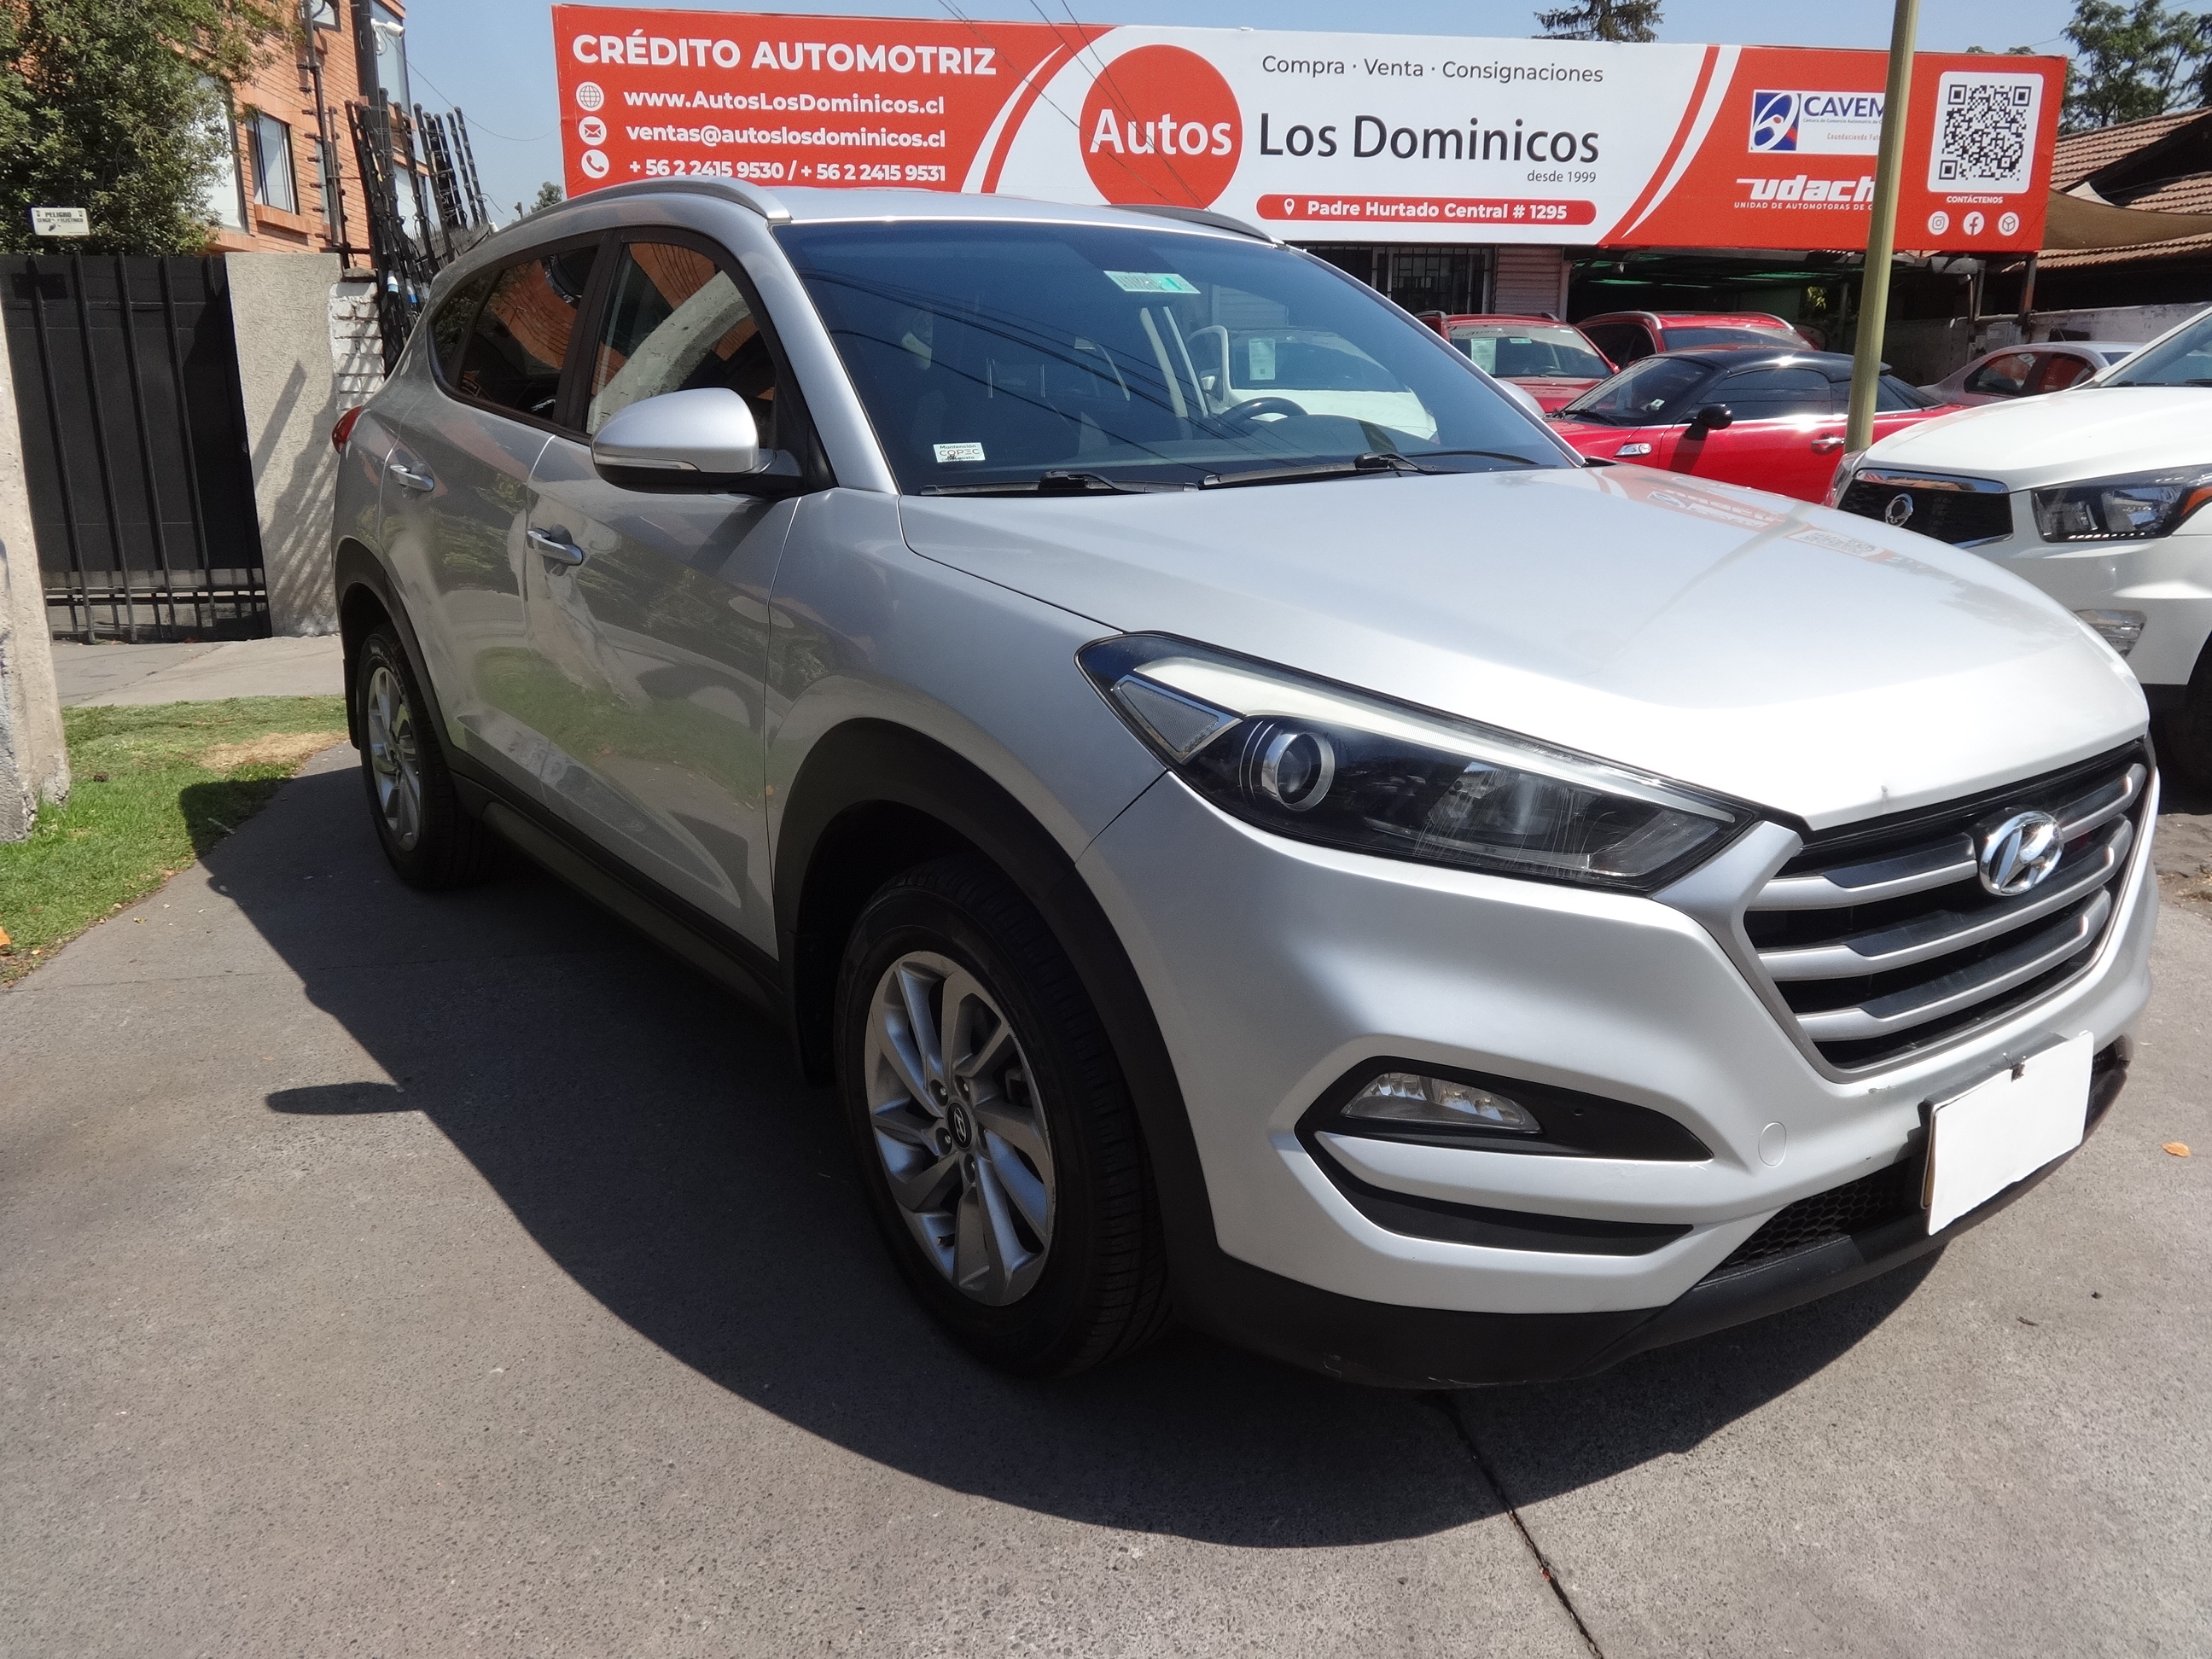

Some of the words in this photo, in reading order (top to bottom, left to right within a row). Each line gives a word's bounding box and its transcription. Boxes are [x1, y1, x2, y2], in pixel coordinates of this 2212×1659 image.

[573, 29, 741, 68] CRÉDITO
[751, 41, 997, 75] AUTOMOTRIZ
[1262, 55, 1345, 79] Compra
[1363, 58, 1423, 78] Venta
[1442, 61, 1604, 84] Consignaciones
[623, 90, 945, 114] www.AutosLosDominicos.cl
[626, 125, 946, 148] ventas@autoslosdominicos.cl
[1089, 108, 1232, 156] Autos
[1260, 113, 1337, 158] Los
[1353, 114, 1599, 164] Dominicos
[645, 159, 671, 177] 56
[672, 160, 686, 176] 2
[689, 160, 733, 178] 2415
[736, 161, 784, 179] 9530
[816, 163, 841, 180] 56
[843, 164, 856, 180] 2
[859, 164, 901, 181] 2415
[905, 165, 946, 182] 9531
[1528, 169, 1563, 183] desde
[1567, 171, 1597, 183] 1999
[1307, 200, 1361, 216] Padre
[1365, 201, 1440, 218] Hurtado
[1444, 202, 1509, 218] Central
[1529, 204, 1568, 220] 1295
[1785, 202, 1850, 211] AUTOMOTORAS
[1946, 195, 2004, 204] CONTÁCTENOS
